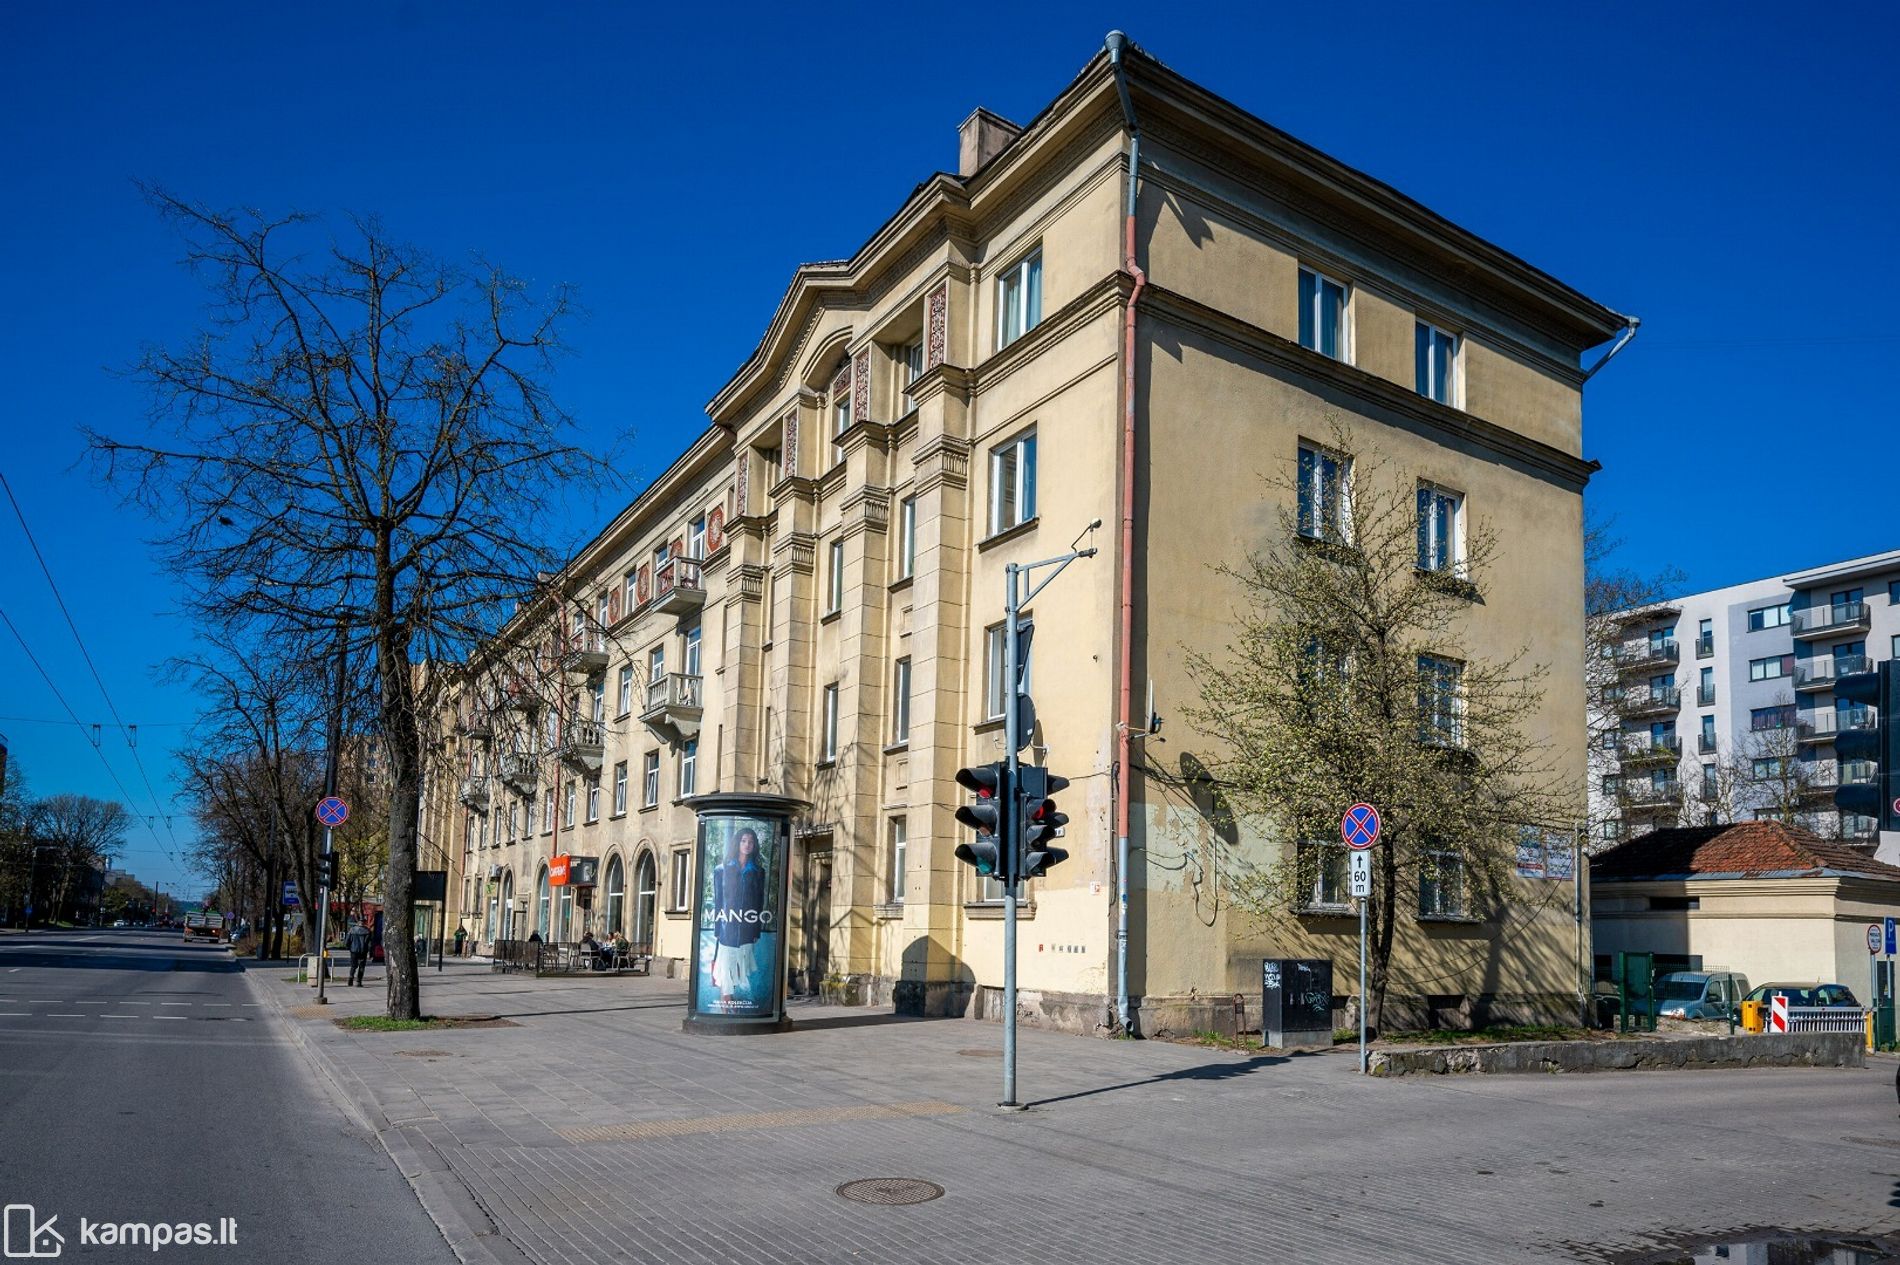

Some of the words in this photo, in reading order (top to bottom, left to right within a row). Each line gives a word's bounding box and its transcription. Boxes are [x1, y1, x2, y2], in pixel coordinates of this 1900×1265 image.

[1354, 870, 1366, 882] 60
[1356, 884, 1364, 893] m
[704, 908, 773, 924] MANGO
[1888, 919, 1894, 938] P
